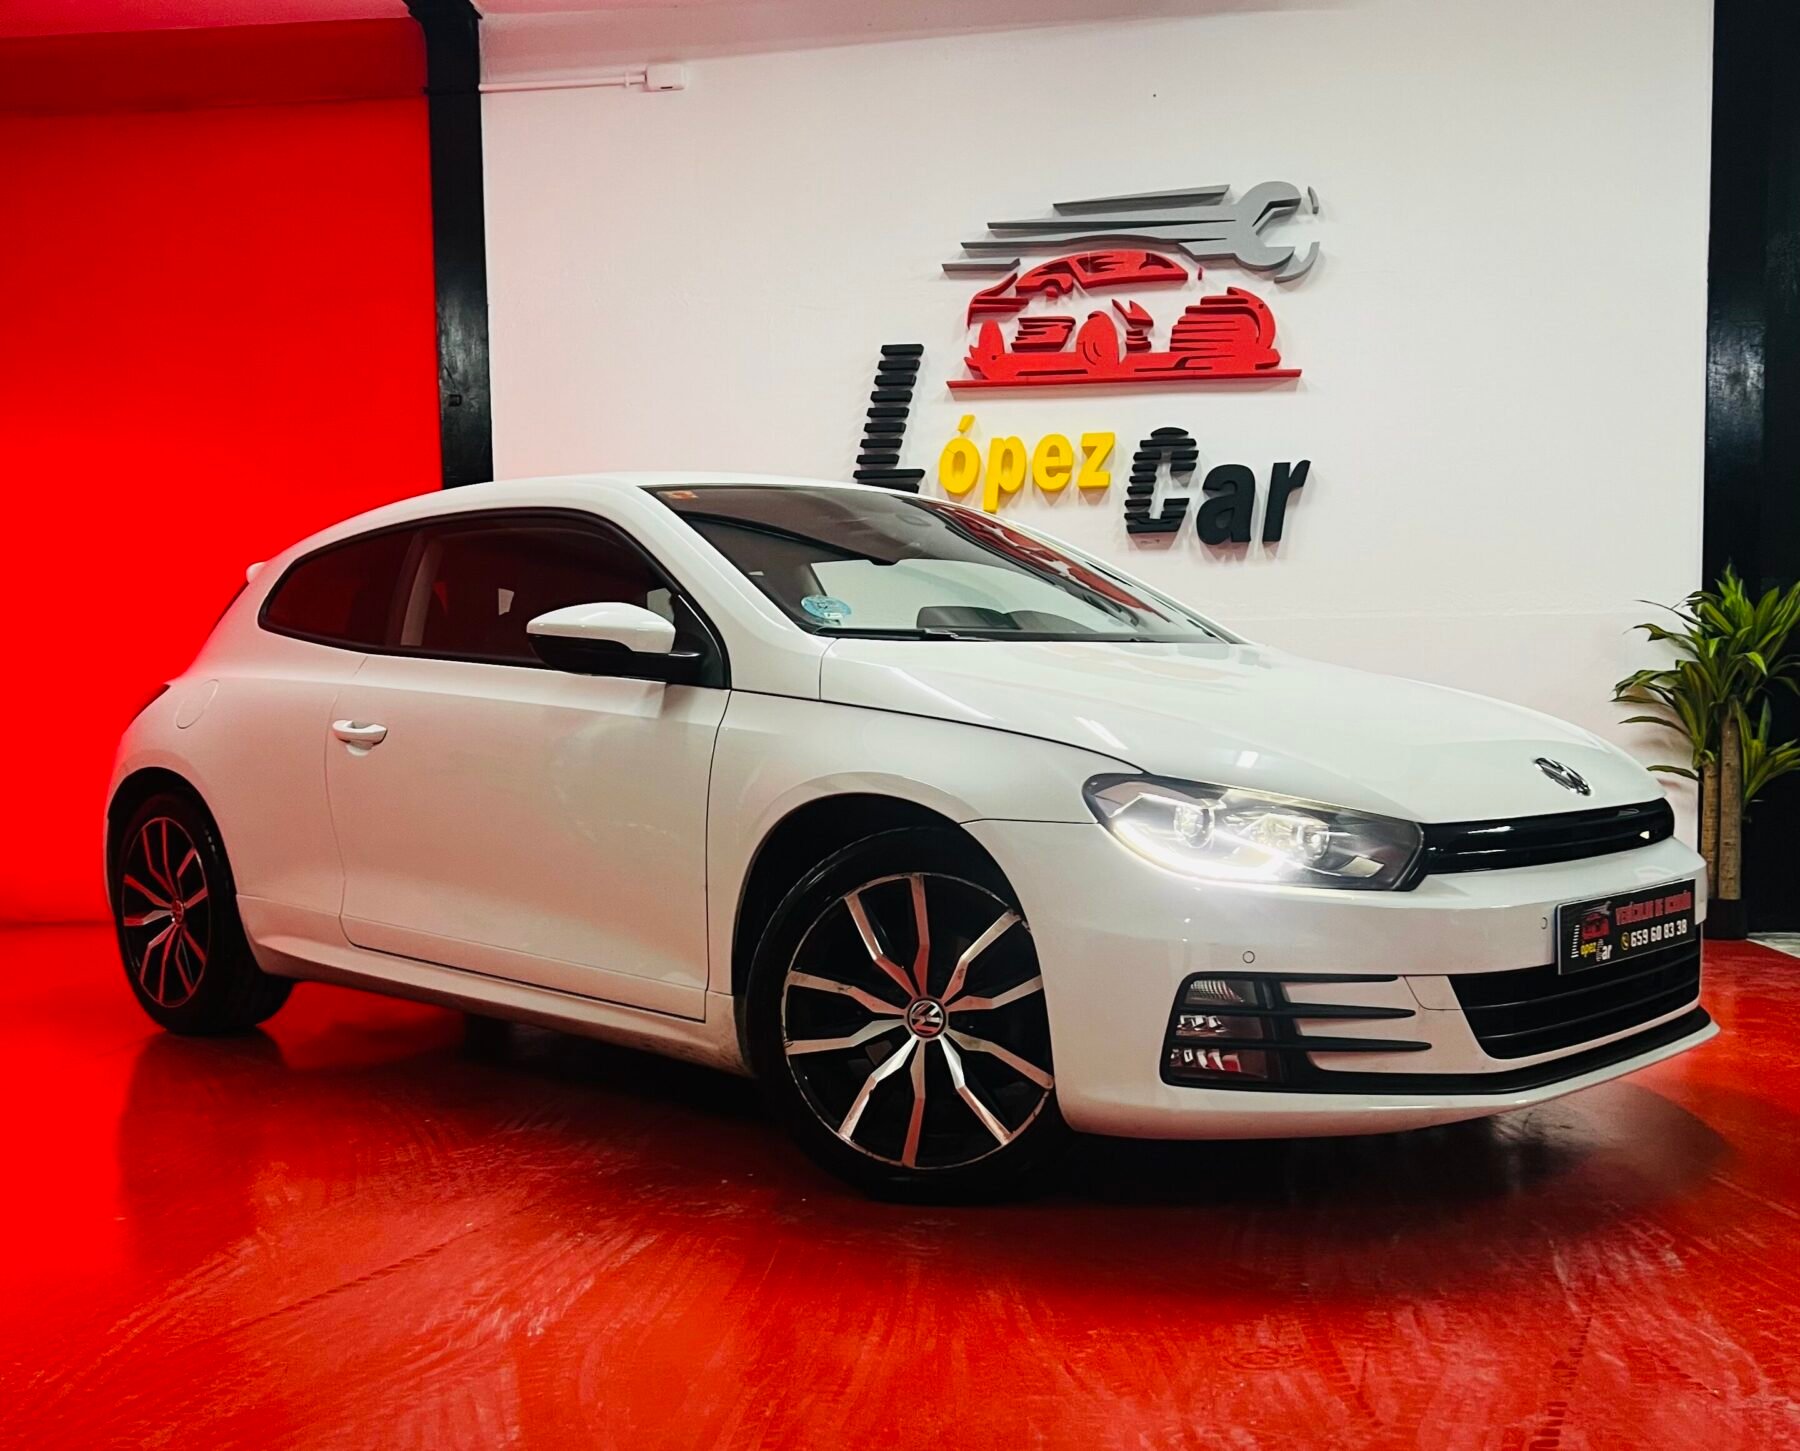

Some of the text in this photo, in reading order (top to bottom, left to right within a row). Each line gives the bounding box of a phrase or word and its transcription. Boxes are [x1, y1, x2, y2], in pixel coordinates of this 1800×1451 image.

[853, 343, 1311, 545] López Car
[1630, 918, 1688, 948] 659 60 83 38
